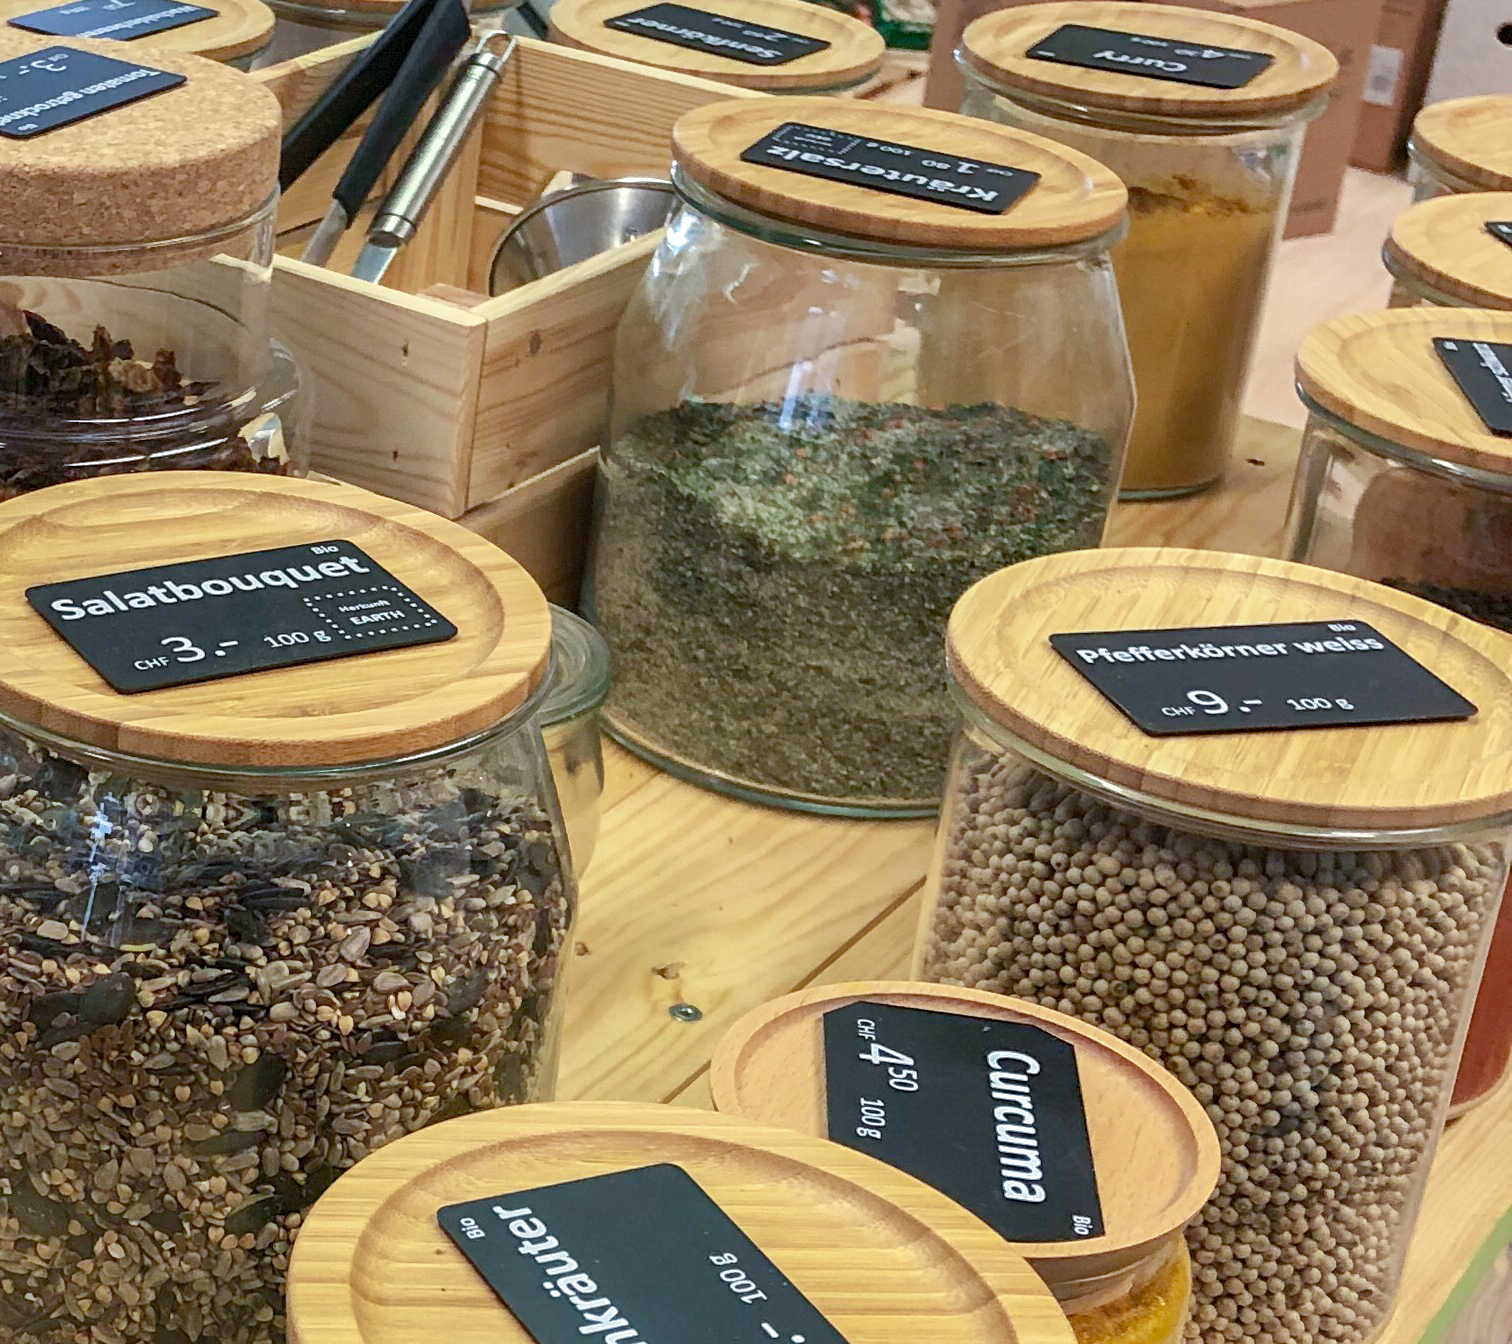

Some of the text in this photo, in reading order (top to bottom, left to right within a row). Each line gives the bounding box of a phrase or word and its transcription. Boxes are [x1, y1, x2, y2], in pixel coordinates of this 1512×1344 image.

[1091, 50, 1188, 73] Curry
[78, 68, 162, 96] Tomaten
[765, 144, 1000, 203] Kräutersalz
[310, 542, 340, 556] Bio
[49, 554, 373, 623] Salatbouquet
[1326, 622, 1358, 634] Bio
[133, 654, 170, 673] CHF
[263, 630, 310, 650] 100
[311, 627, 333, 644] g
[1075, 635, 1387, 666] Pfefferkörner weiss
[1160, 703, 1196, 718] CHF
[1285, 696, 1333, 712] 100
[1334, 697, 1356, 712] g
[855, 1017, 877, 1041] CHF
[859, 1096, 887, 1127] 100
[854, 1126, 883, 1141] g
[986, 1049, 1048, 1204] Curcuma
[458, 1216, 487, 1242] Bio
[1071, 1213, 1094, 1237] Bio
[708, 1251, 739, 1267] g
[719, 1267, 769, 1306] 100
